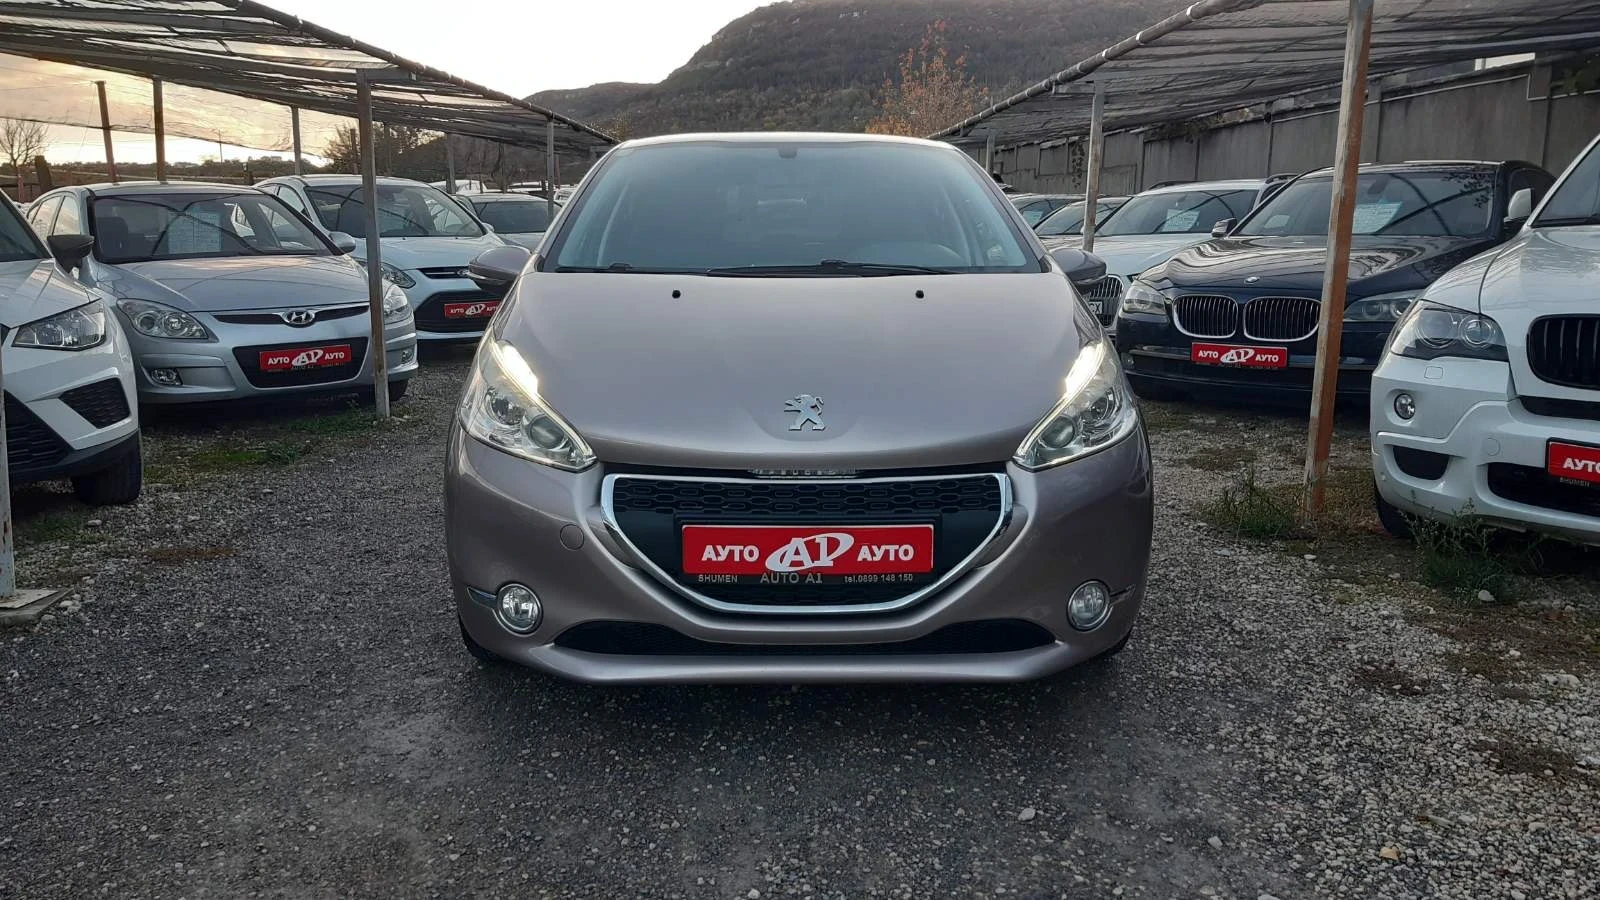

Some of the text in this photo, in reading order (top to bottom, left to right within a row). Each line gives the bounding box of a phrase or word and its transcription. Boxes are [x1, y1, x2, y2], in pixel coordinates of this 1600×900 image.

[267, 356, 290, 366] АУТО
[324, 351, 345, 361] АУТО
[1198, 349, 1219, 359] АУТО
[1255, 353, 1279, 363] АУТО
[701, 544, 760, 562] АУТО
[857, 544, 915, 562] АУТО
[698, 574, 738, 583] SHUMEN
[760, 572, 800, 584] AUTO
[805, 573, 823, 584] A1
[881, 574, 896, 582] 148
[898, 573, 914, 582] 150
